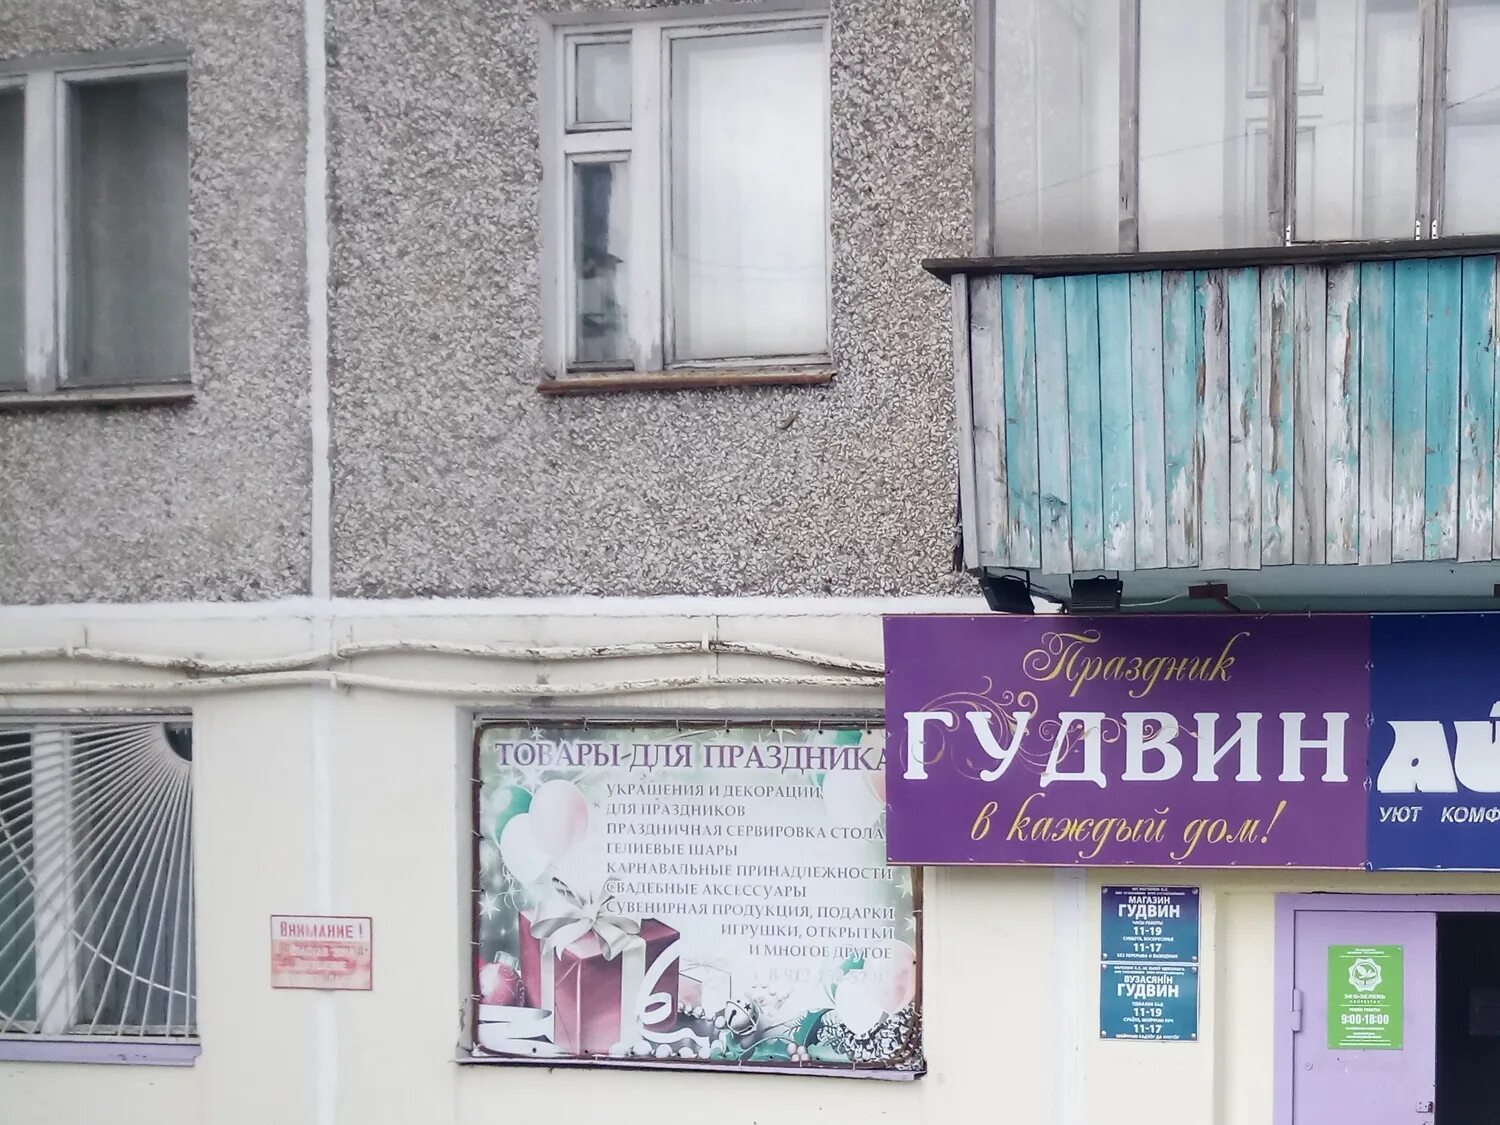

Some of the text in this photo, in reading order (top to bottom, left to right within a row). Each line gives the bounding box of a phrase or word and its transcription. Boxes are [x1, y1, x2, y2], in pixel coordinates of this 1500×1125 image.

[1023, 629, 1250, 698] Праздник
[495, 742, 622, 768] ТОВАРЫ
[629, 743, 692, 772] ДЛЯ
[902, 711, 1350, 788] ГУДВИН
[606, 783, 704, 797] УКРАШЕНИЯ
[708, 785, 719, 797] И
[605, 803, 745, 818] ДЛЯ ПРАЗДНИКОВ
[1378, 806, 1423, 824] УЮТ
[606, 822, 884, 840] ПРАЗДНИЧНАЯ СЕРВИРОВКА СТОЛА
[970, 792, 1288, 861] в каждый дом!
[606, 843, 738, 857] ГЕЛИЕВЫЕ ШАРЫ
[606, 862, 892, 880] КАРНАВАЛЬНЫЕ ПРИНАДЛЕЖНОСТИ
[606, 882, 806, 899] СВАДЕБНЫЕ АКСЕССУАРЫ
[1128, 896, 1171, 904] МАГАЗИН
[606, 901, 894, 921] СУВЕНИРНАЯ ПРОДУКЦИЯ, ПОДАРКИ
[1118, 904, 1180, 920] ГУДВИН
[721, 923, 894, 940] ИГРУШКИ, ОТКРЫТКИ
[1133, 926, 1162, 936] 11-19
[749, 944, 892, 963] И МНОГОЕ ДРУГОЕ
[1133, 943, 1162, 952] 11-17
[1117, 983, 1179, 999] ГУДВИН
[1133, 1008, 1162, 1017] 11-19
[1133, 1024, 1162, 1033] 11-17
